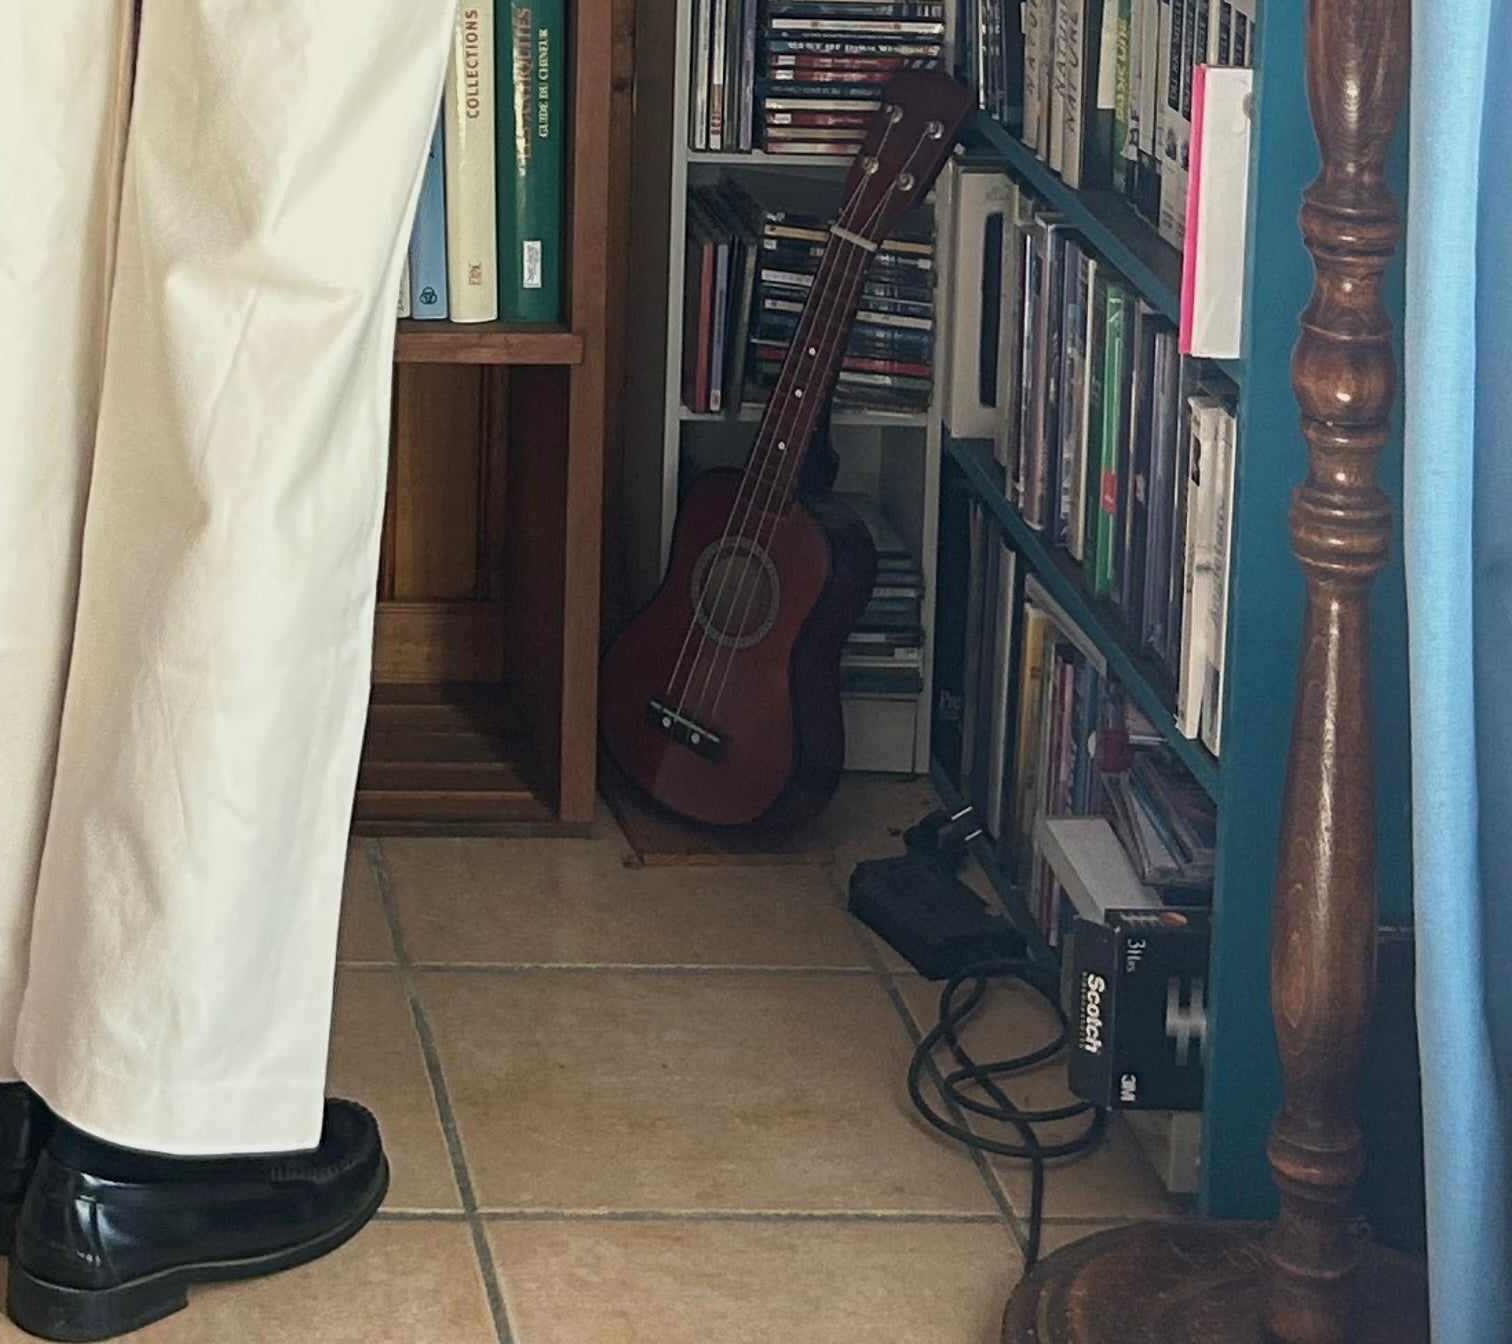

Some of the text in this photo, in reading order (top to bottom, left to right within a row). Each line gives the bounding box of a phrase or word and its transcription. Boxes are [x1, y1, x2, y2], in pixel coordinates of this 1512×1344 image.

[460, 8, 484, 120] COLLECTIONS
[536, 28, 550, 137] GUIDE DU CHINEUR
[1085, 972, 1106, 1053] Scotch
[1119, 1073, 1137, 1103] 3M
